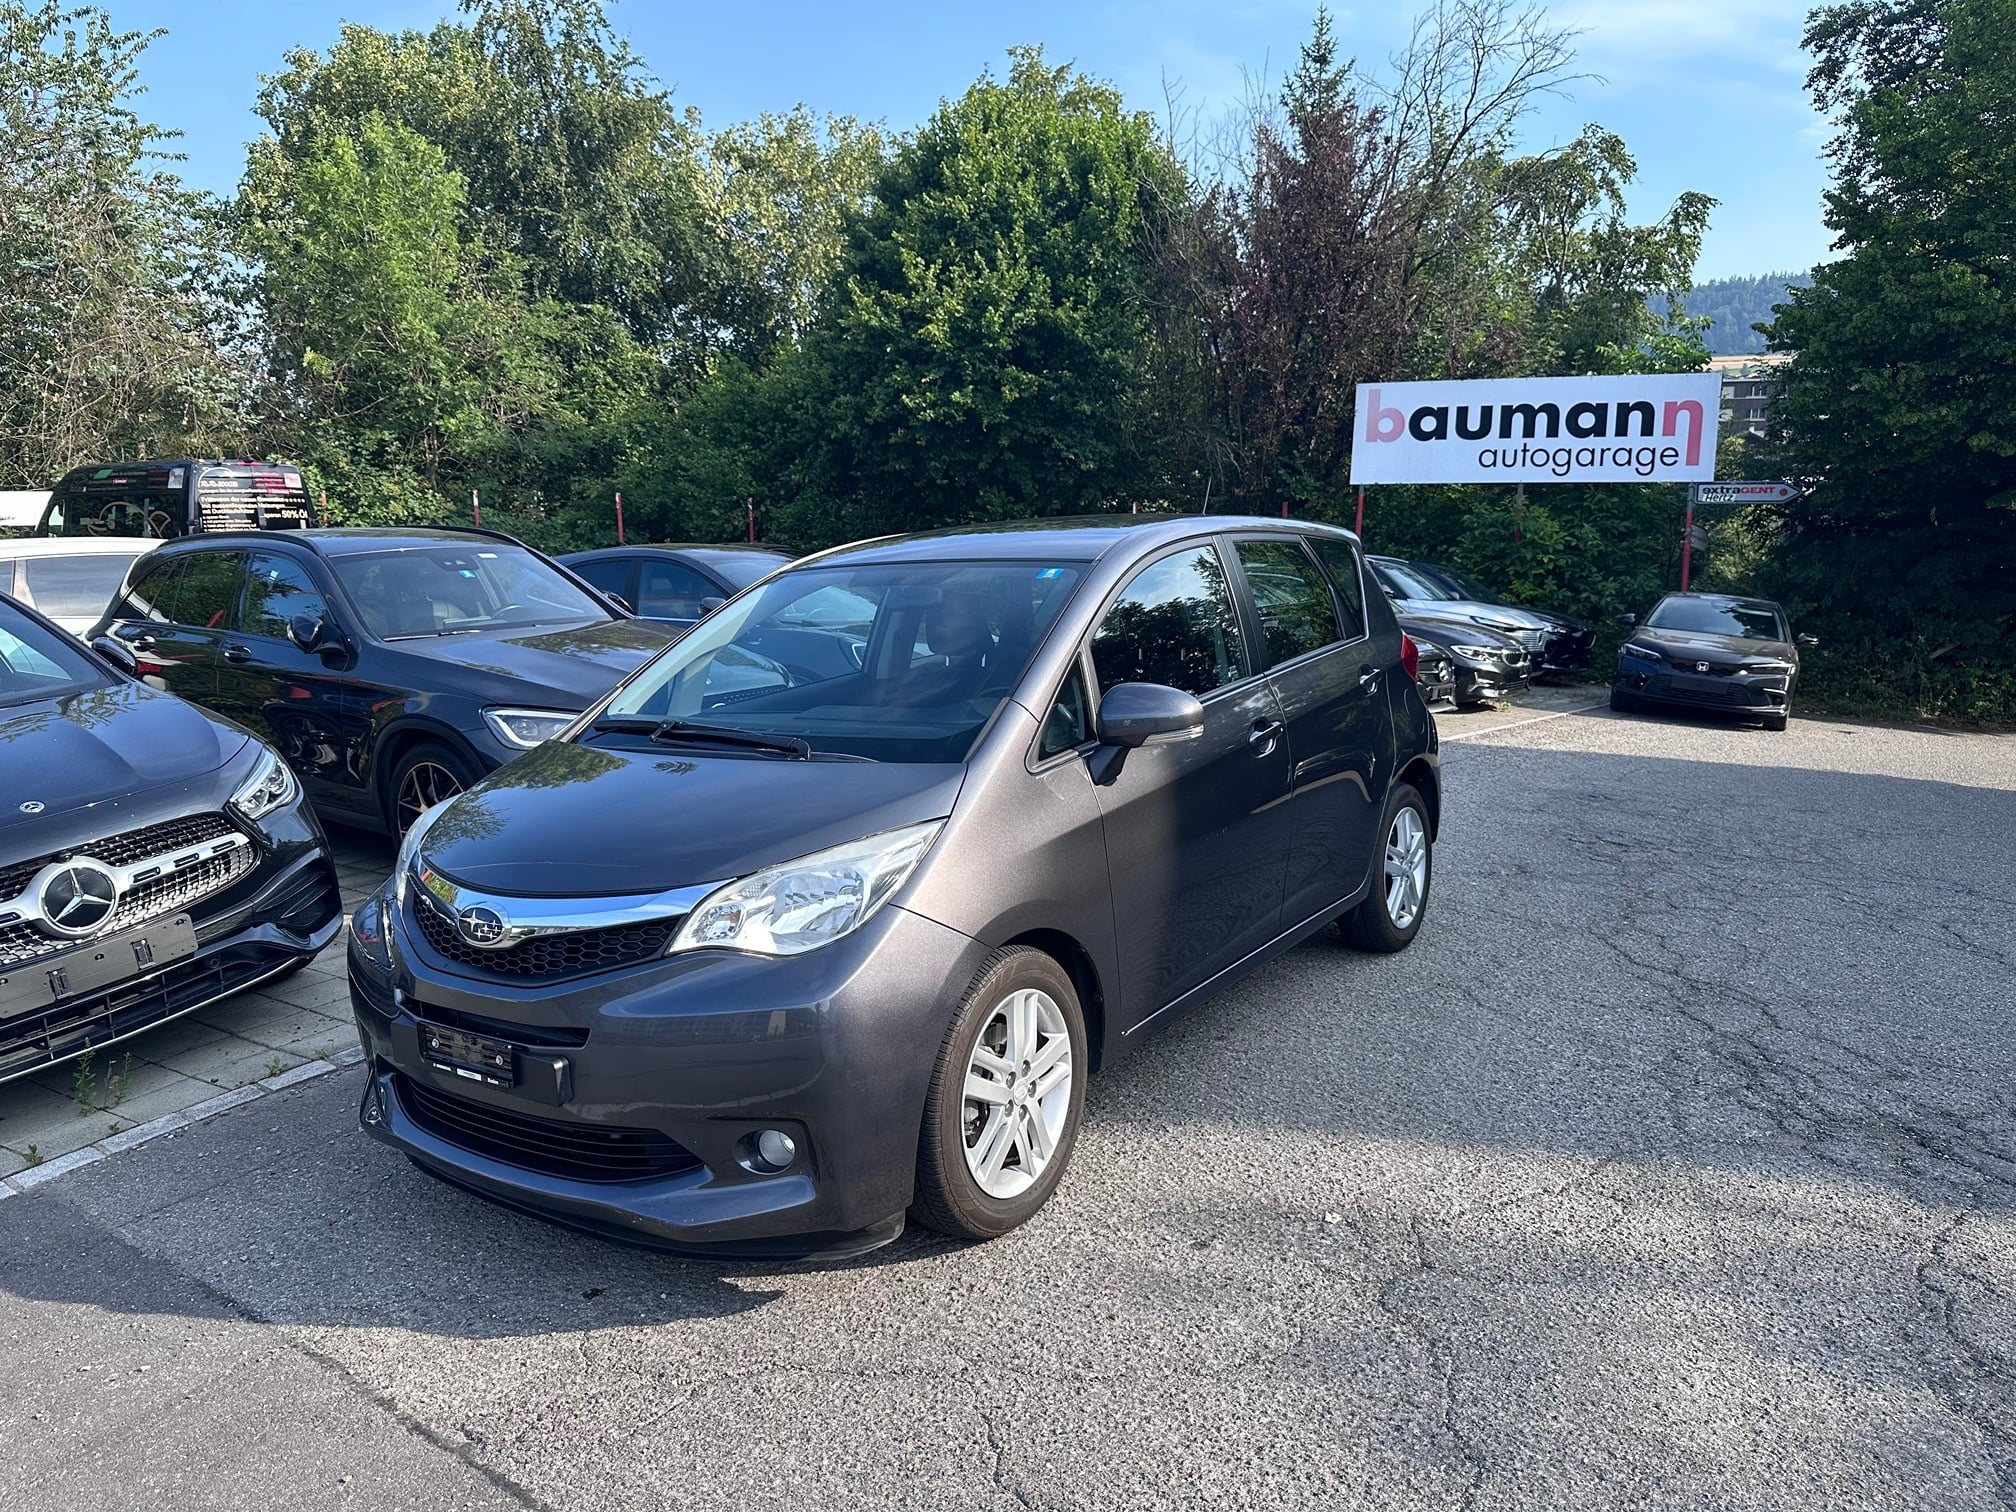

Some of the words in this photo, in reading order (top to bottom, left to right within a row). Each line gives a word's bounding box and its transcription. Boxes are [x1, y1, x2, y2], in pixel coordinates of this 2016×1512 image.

[1365, 388, 1704, 467] baumann
[1478, 442, 1680, 477] autogarage
[1702, 485, 1776, 495] extraGENT
[281, 509, 299, 519] 50%
